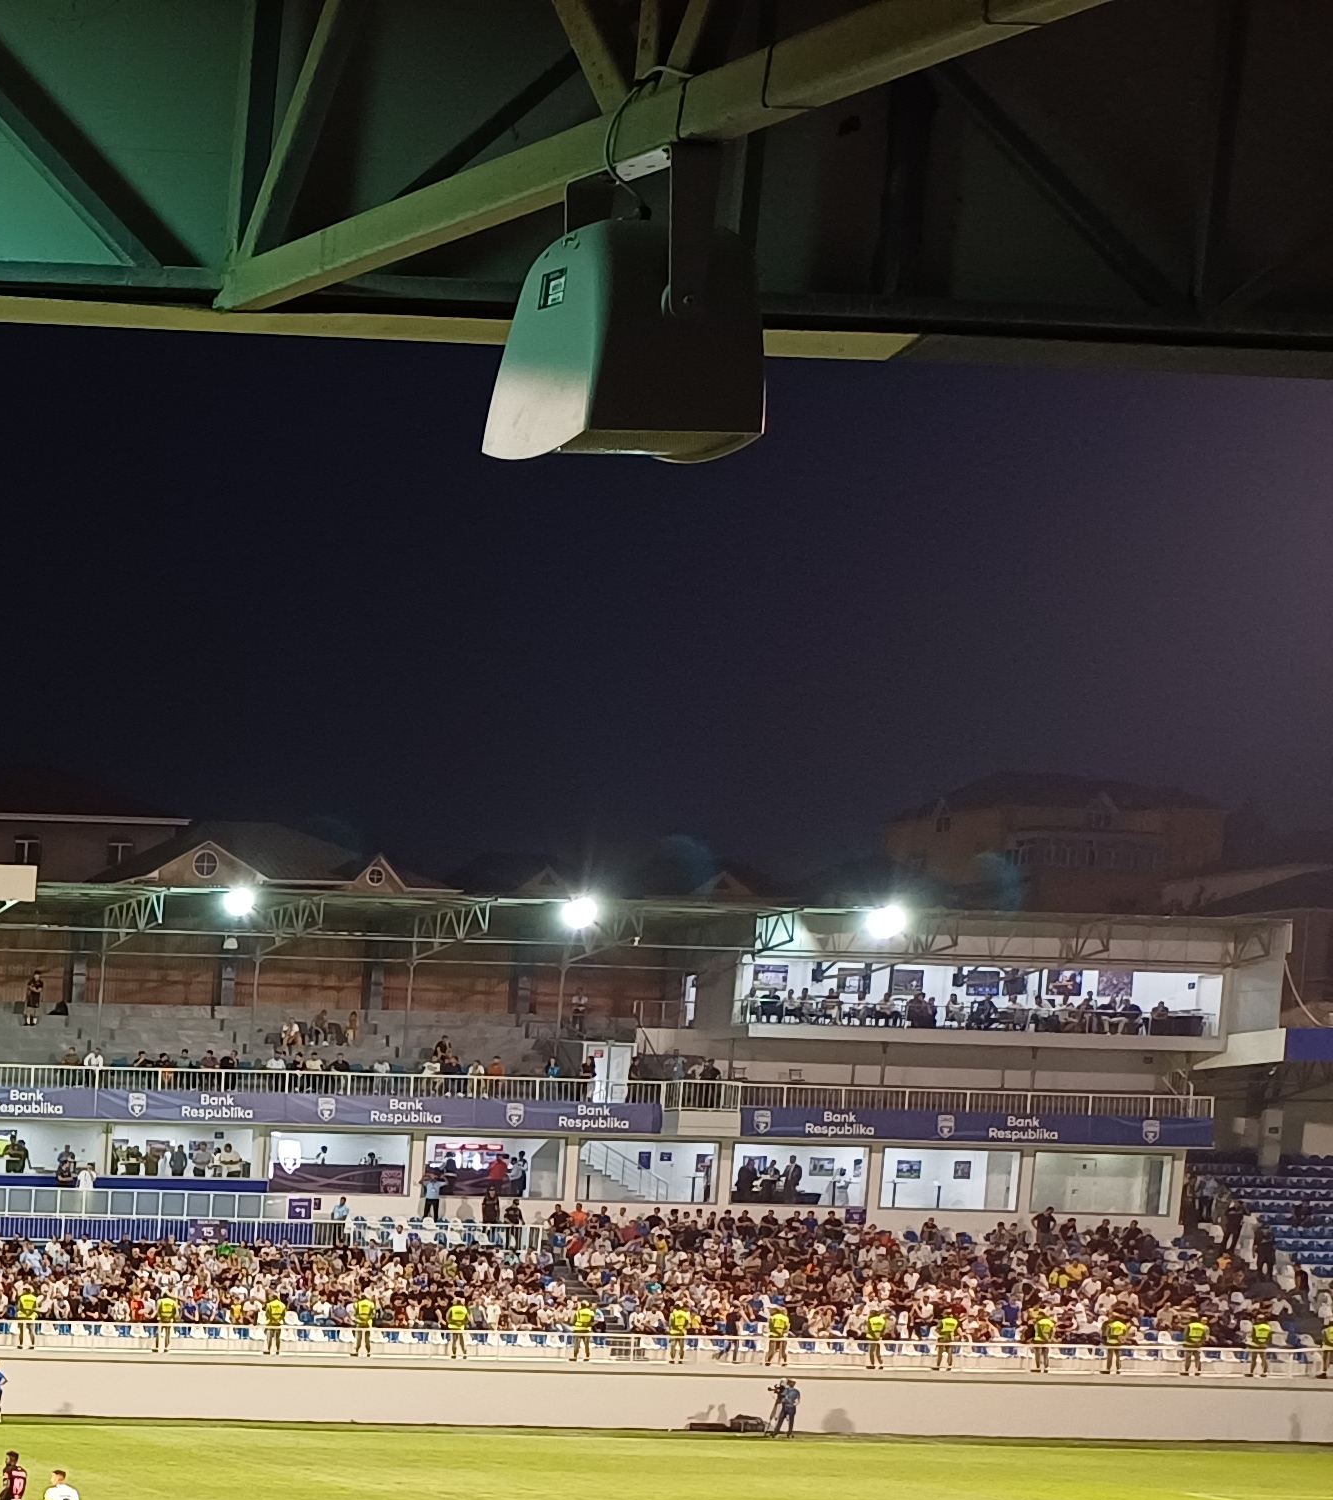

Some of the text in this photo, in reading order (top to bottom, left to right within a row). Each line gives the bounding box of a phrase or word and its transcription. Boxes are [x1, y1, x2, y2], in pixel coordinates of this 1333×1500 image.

[9, 1089, 44, 1102] Bank
[200, 1093, 235, 1106] Bank
[389, 1098, 423, 1111] Bank
[577, 1104, 611, 1117] Bank
[181, 1105, 254, 1120] Respublika
[370, 1109, 442, 1124] Respublika
[823, 1111, 856, 1124] Bank
[558, 1115, 629, 1130] Respublika
[1007, 1115, 1040, 1128] Bank
[804, 1123, 875, 1137] Respublika
[988, 1127, 1059, 1141] Respublika
[201, 1226, 215, 1237] 15
